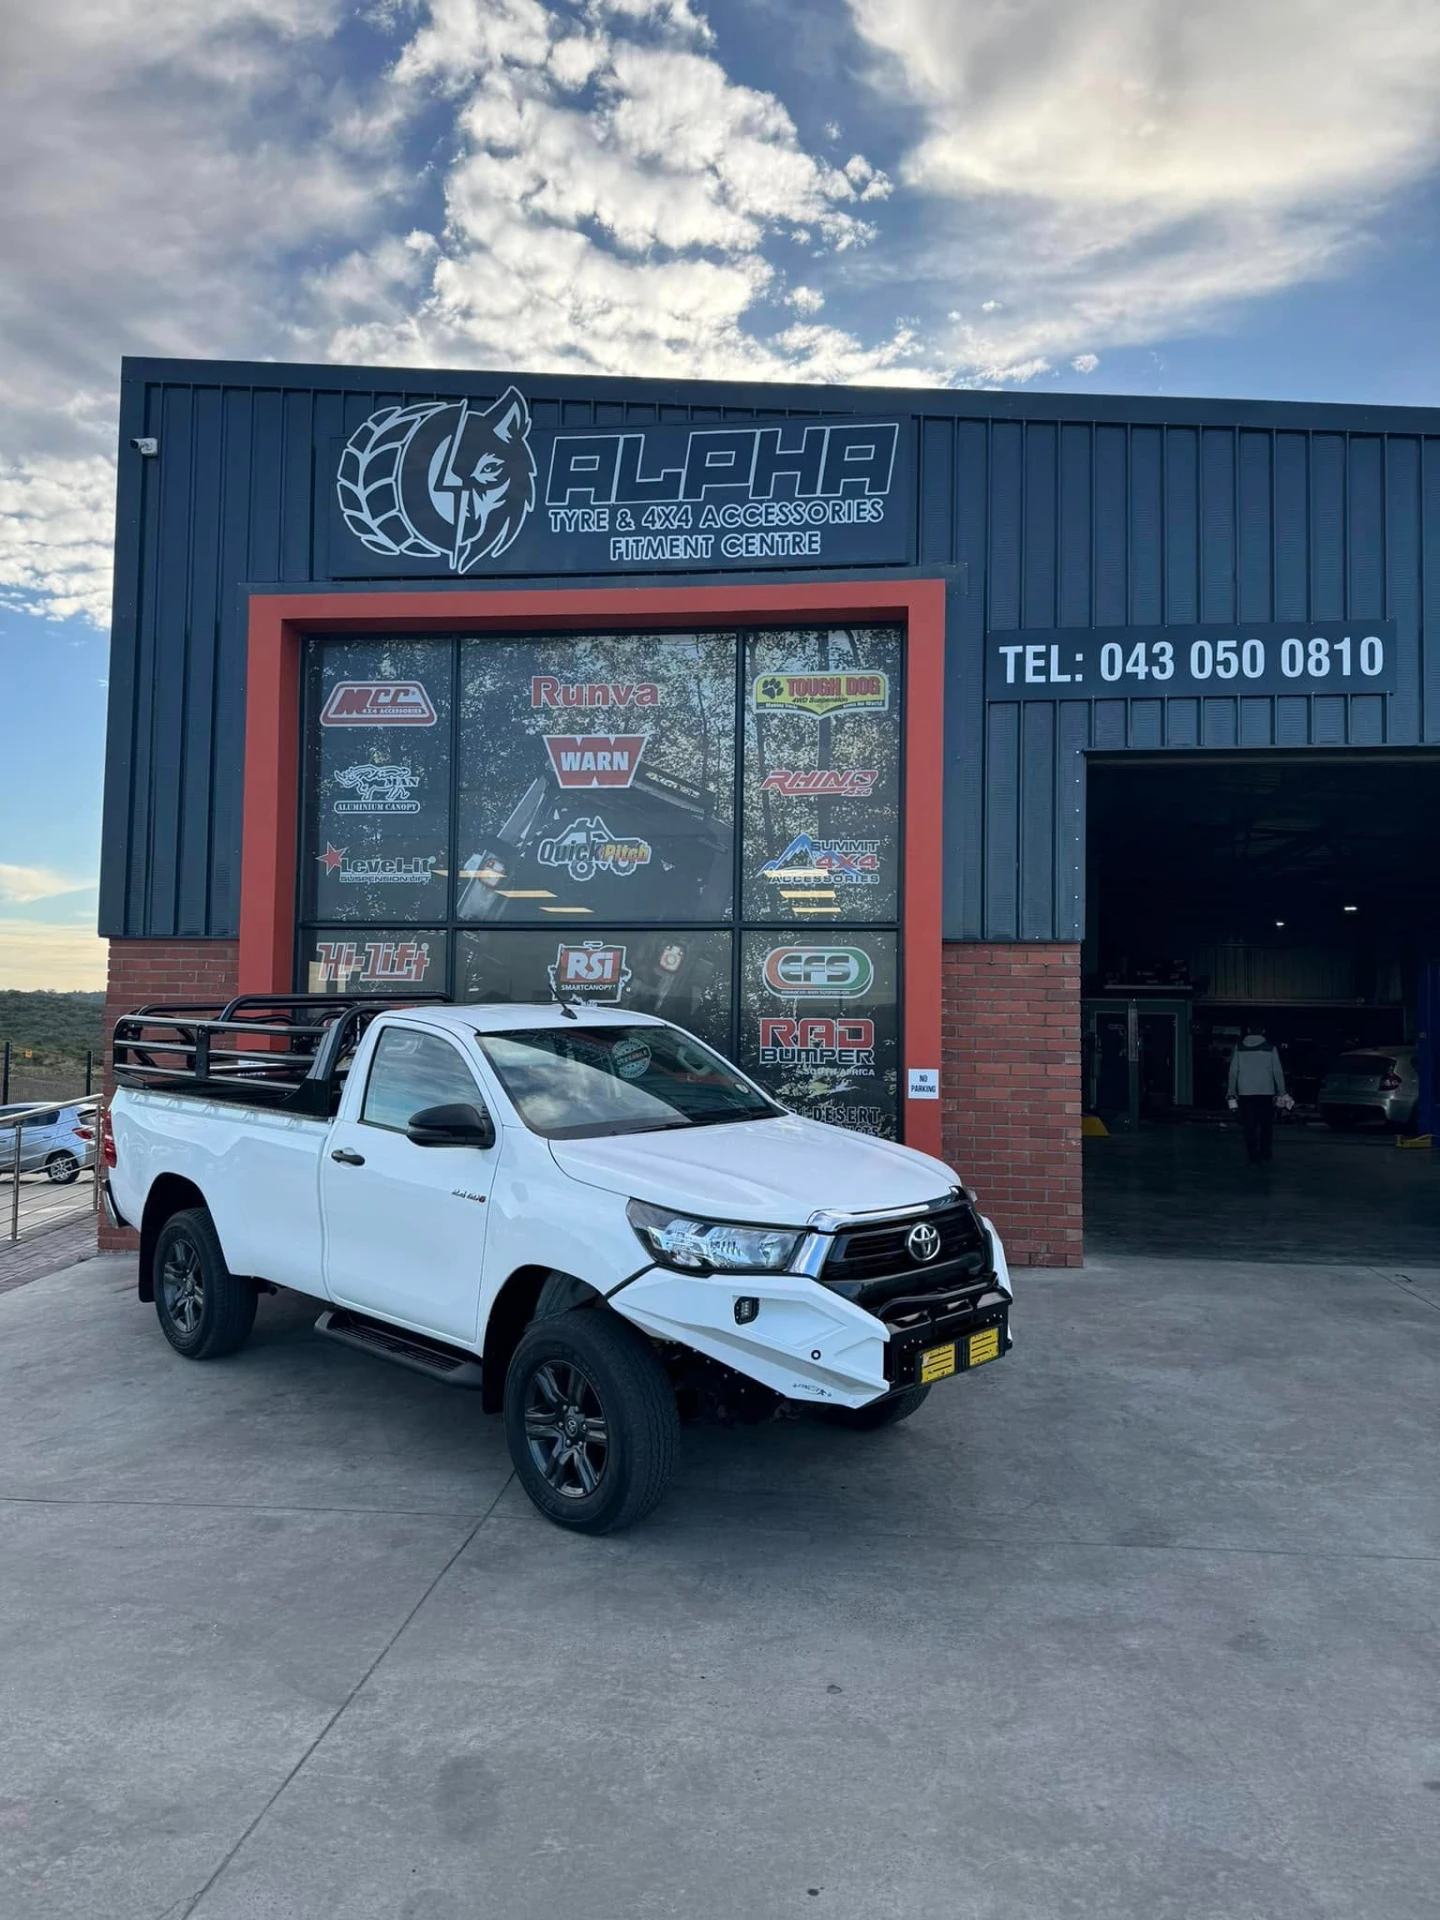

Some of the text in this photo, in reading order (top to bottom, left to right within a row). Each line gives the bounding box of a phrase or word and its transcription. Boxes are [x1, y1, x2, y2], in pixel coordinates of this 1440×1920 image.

[545, 423, 899, 505] ALPHA
[549, 498, 884, 532] TYRE & 4X4 ACCESSORIES
[611, 531, 820, 560] FITMENT CENTRE
[999, 636, 1384, 684] TEL: 043 050 0810
[531, 676, 660, 707] Runva
[786, 676, 881, 697] TOUGH DOG
[560, 751, 629, 771] WARN
[761, 770, 879, 795] RHINO
[337, 803, 417, 811] ALUMINIUM CANOPY
[811, 840, 880, 852] SUMMIT
[340, 874, 408, 882] SUSPENSION
[770, 874, 880, 884] ACCESSORIES
[780, 955, 851, 982] EFS
[760, 1018, 875, 1049] RAD
[760, 1047, 876, 1064] BUMPER
[839, 1067, 875, 1077] AFRICA
[919, 1074, 928, 1082] NO
[910, 1084, 936, 1093] PARKING
[813, 1106, 881, 1123] DESERT
